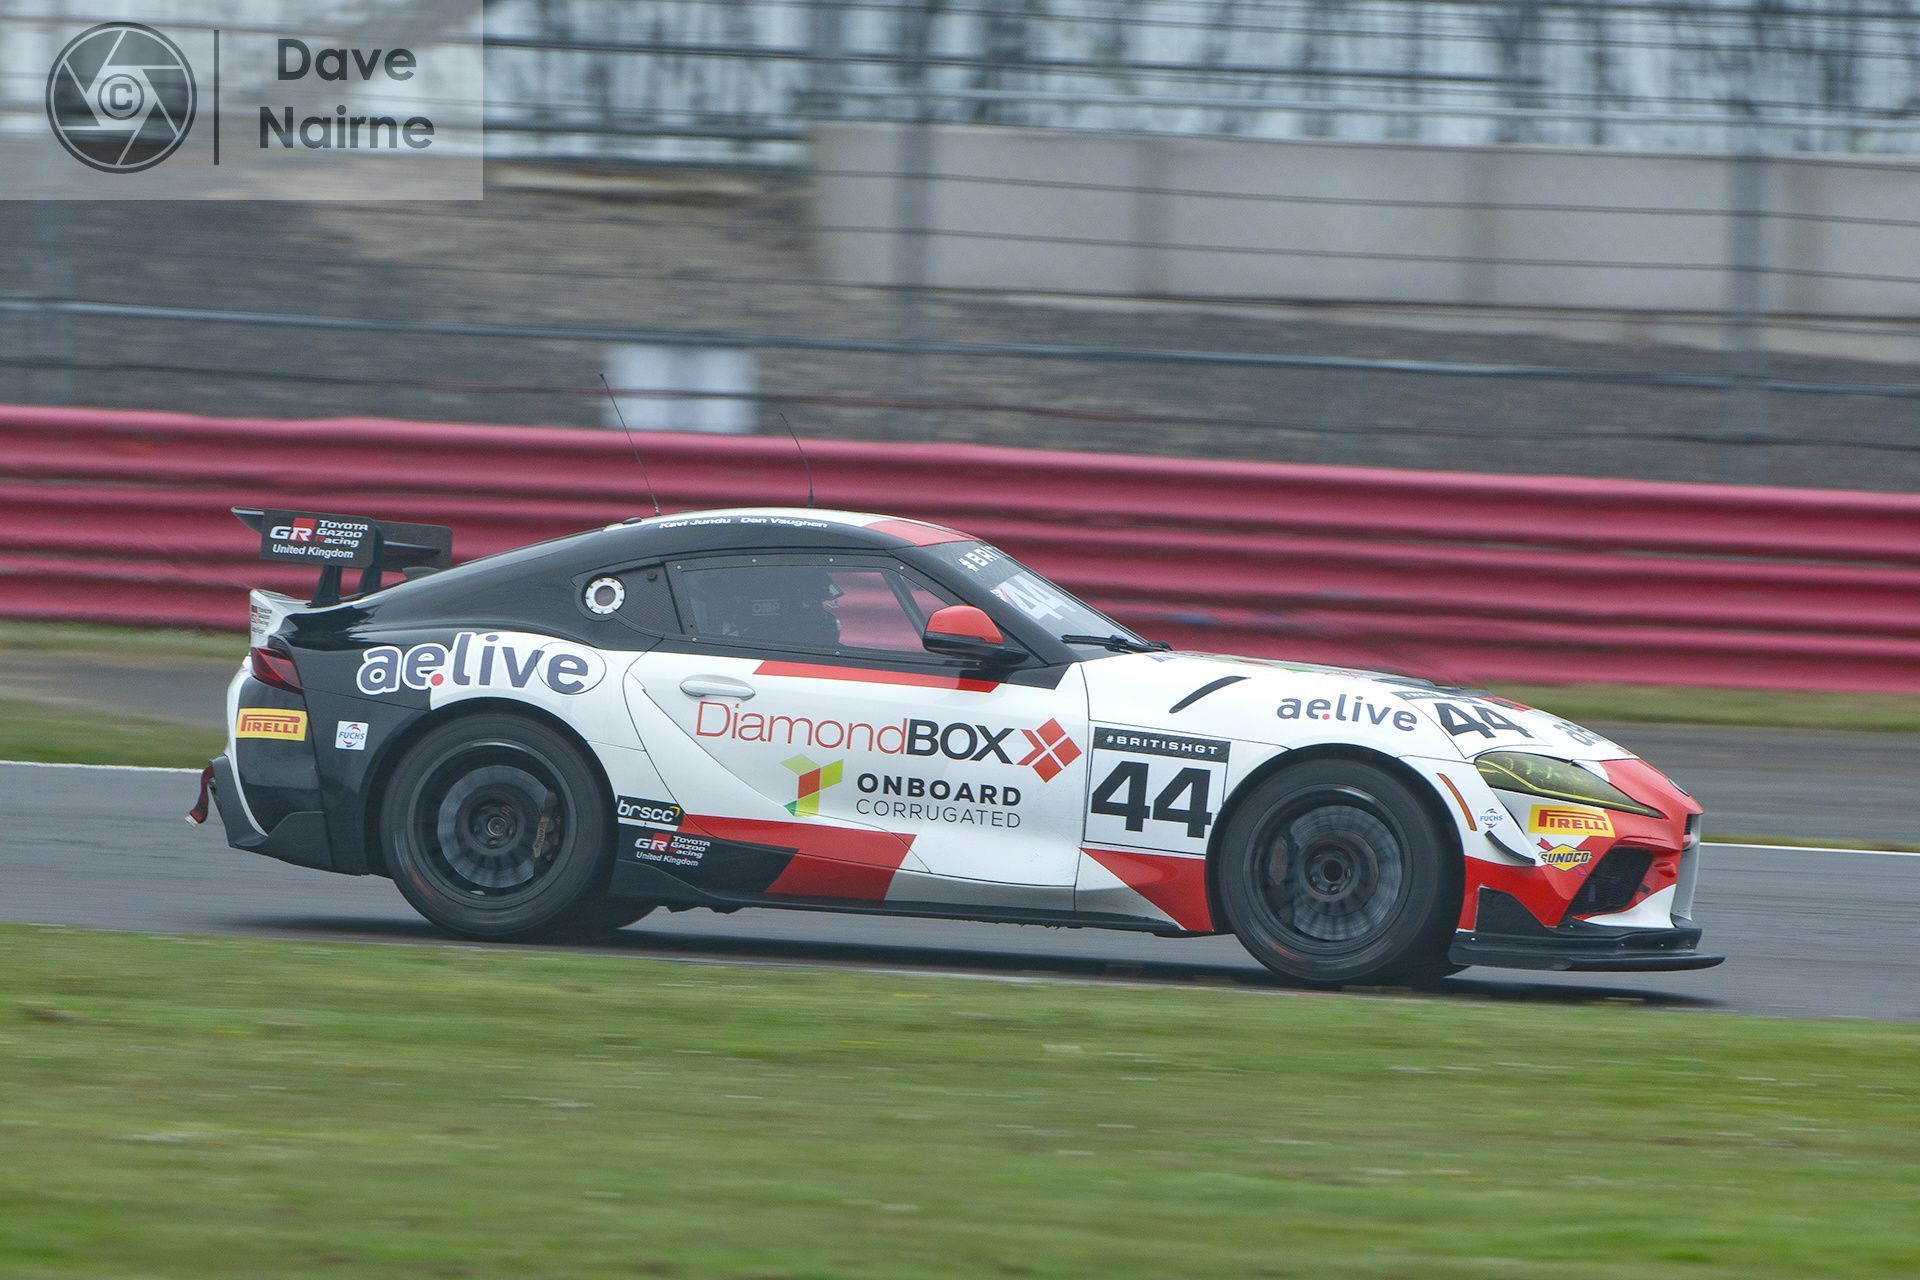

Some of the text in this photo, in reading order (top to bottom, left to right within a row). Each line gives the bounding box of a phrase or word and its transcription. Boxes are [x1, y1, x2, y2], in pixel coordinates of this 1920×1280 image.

[319, 519, 369, 531] TOYOTA
[690, 517, 731, 526] Jundu
[770, 518, 828, 528] Vaughan
[269, 526, 312, 542] GR
[316, 528, 363, 539] GAZOO
[272, 544, 354, 559] United Kingdom
[240, 714, 301, 734] PIRELLI
[1434, 702, 1535, 739] 44
[338, 732, 365, 740] FUCHS
[696, 701, 1015, 765] DiamondBOX
[1106, 735, 1218, 755] #BRITISHGT
[857, 772, 1022, 807] ONBOARD
[1091, 761, 1212, 839] 44
[617, 800, 674, 822] brscc
[856, 798, 1021, 829] CORRUGATED
[1480, 814, 1503, 822] FUCHS
[1538, 809, 1609, 831] PIRELLI
[635, 838, 668, 852] GR
[670, 841, 706, 852] GAZOO
[672, 835, 711, 847] TOYOTA
[636, 851, 699, 867] United Kingdom
[1540, 852, 1590, 863] SUNOCO
